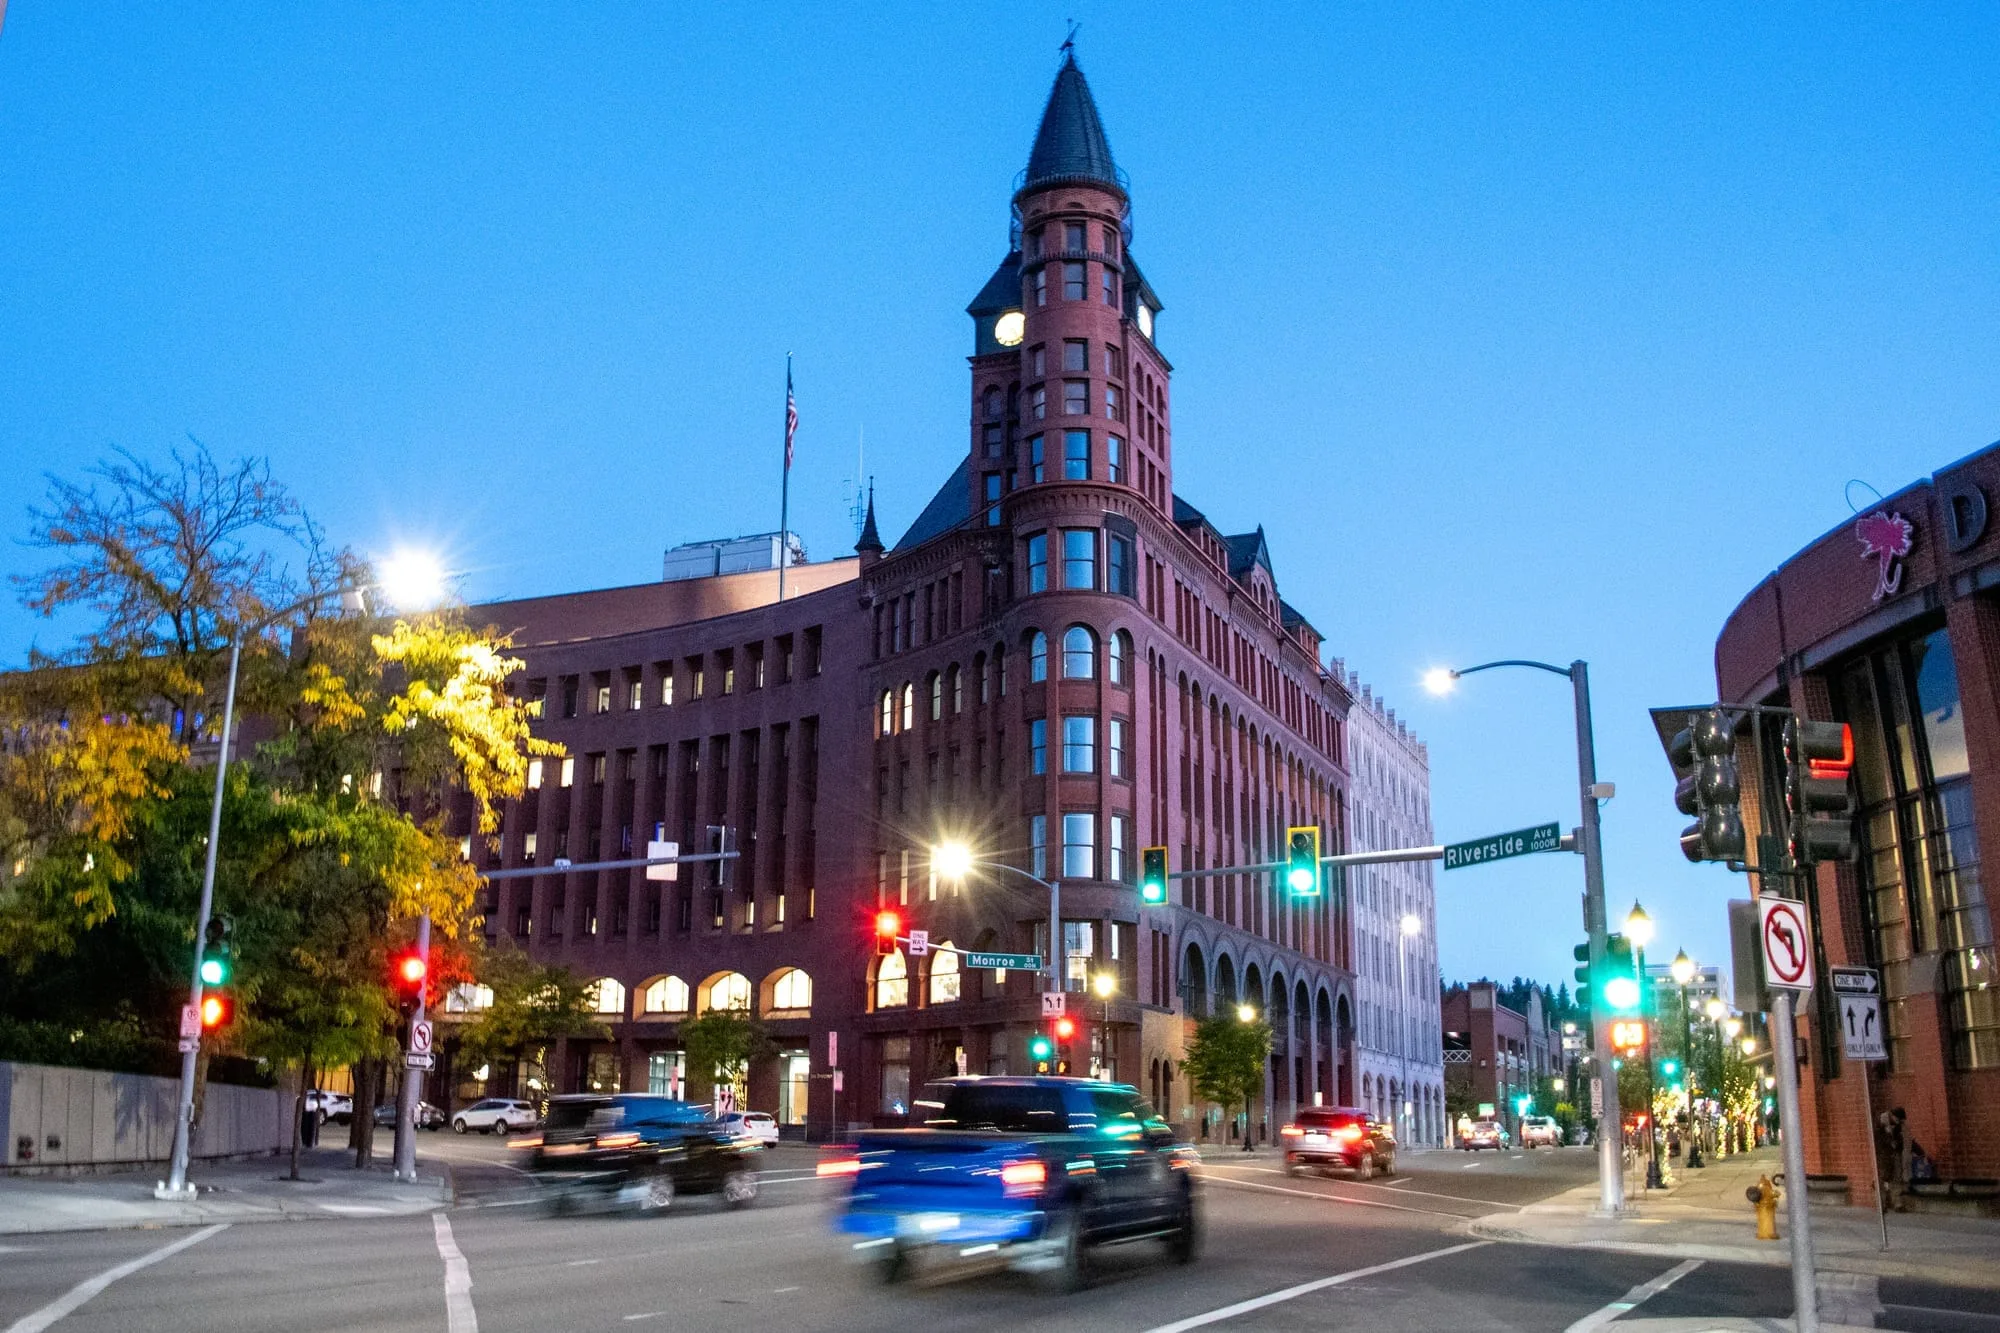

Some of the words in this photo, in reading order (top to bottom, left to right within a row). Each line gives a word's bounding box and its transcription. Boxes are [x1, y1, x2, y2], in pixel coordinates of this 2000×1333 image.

[1943, 480, 1987, 553] D
[1533, 828, 1552, 840] Ave
[1447, 835, 1524, 866] Riverside
[972, 955, 1015, 967] Monroe
[1837, 975, 1850, 986] ONE
[1852, 975, 1865, 986] WAY
